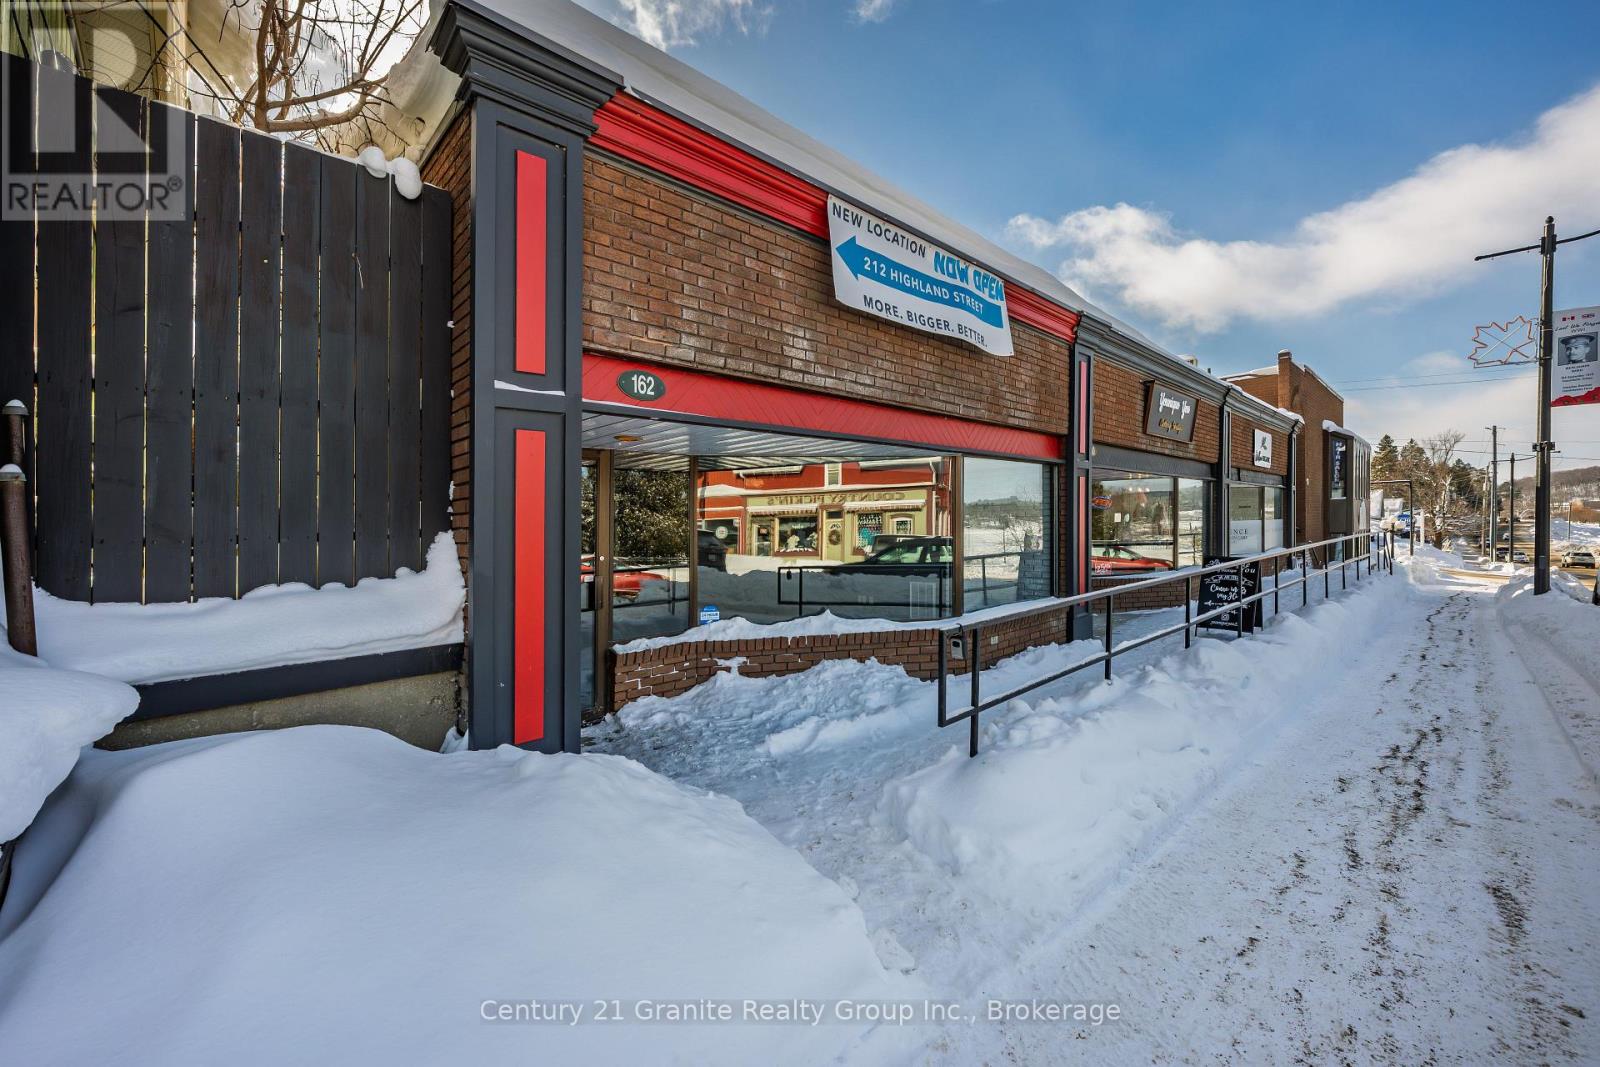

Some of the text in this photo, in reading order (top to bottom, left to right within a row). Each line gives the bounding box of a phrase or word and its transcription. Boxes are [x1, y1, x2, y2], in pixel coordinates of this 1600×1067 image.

[832, 202, 1005, 302] NEW LOCATION NOW OPEN
[863, 256, 984, 314] 212 HIGHLAND STREET
[863, 294, 988, 348] MORE. BIGGER. BETTER.
[631, 374, 655, 396] 162
